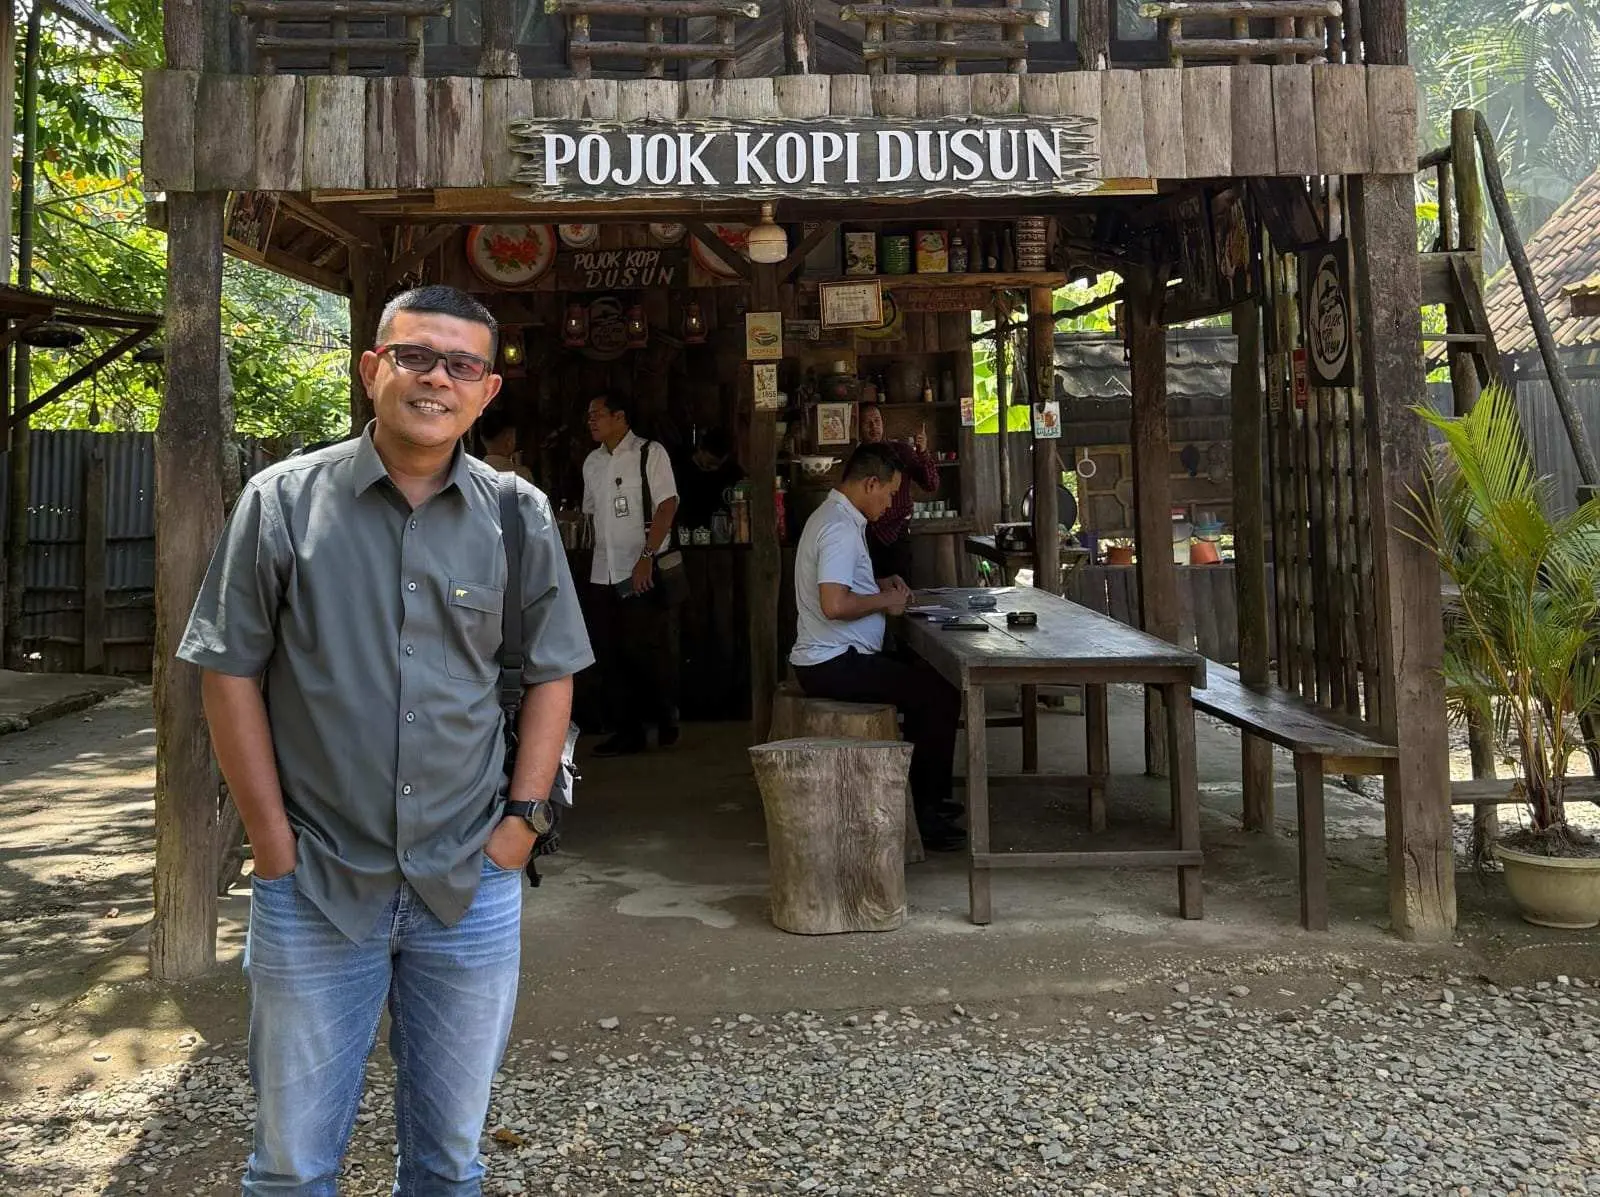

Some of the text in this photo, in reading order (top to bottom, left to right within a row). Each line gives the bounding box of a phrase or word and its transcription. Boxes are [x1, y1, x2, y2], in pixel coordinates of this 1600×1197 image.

[541, 128, 1063, 186] POJOK KOPI DUSUN
[573, 249, 661, 271] POJOK KOPI
[585, 266, 675, 289] DUSUN
